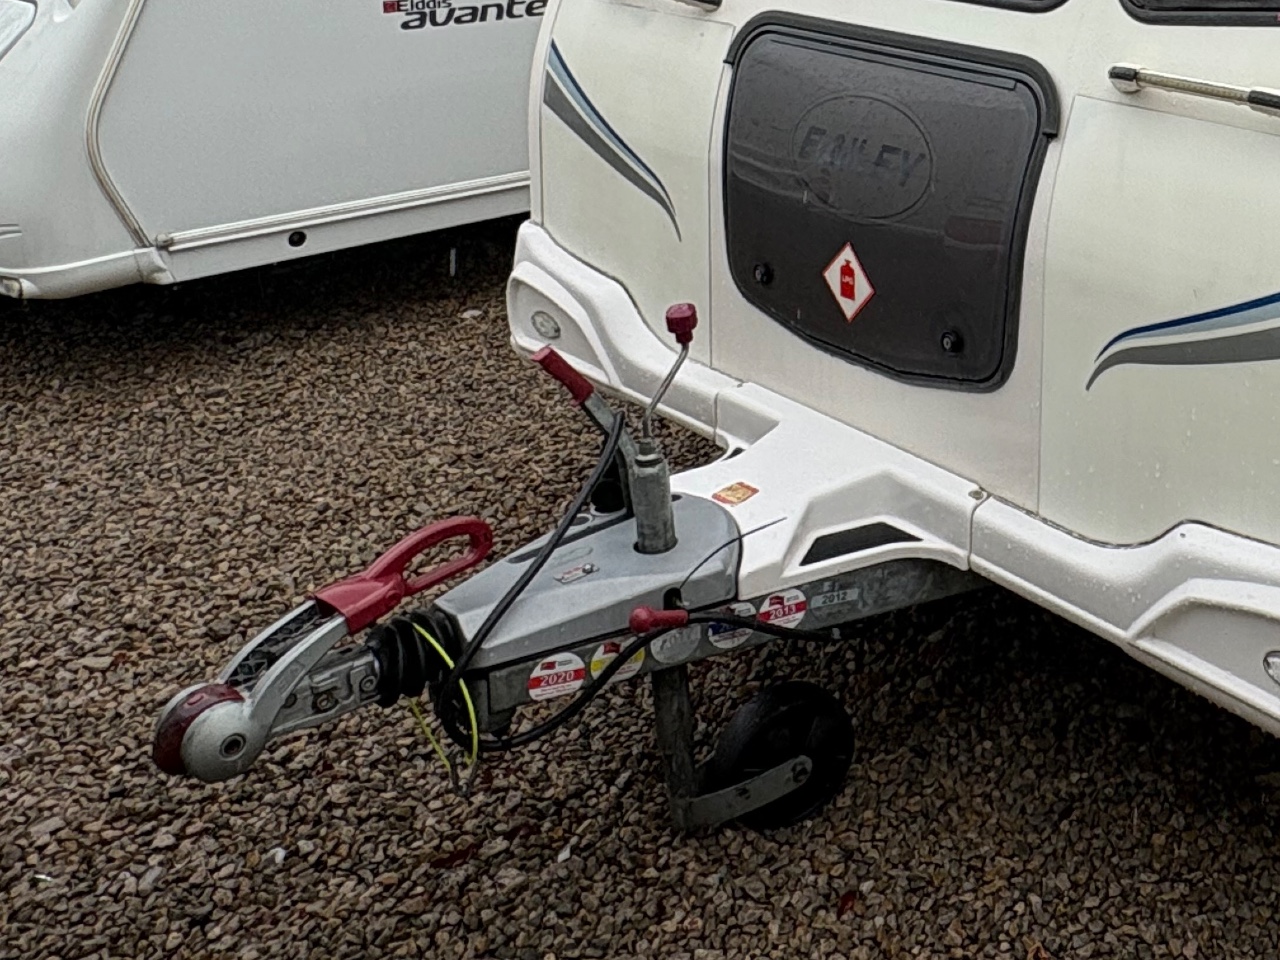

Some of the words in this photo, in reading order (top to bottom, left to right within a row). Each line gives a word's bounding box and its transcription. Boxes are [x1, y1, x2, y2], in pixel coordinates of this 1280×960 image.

[822, 591, 848, 605] 2012
[769, 605, 796, 619] 2013
[540, 670, 575, 686] 2020
